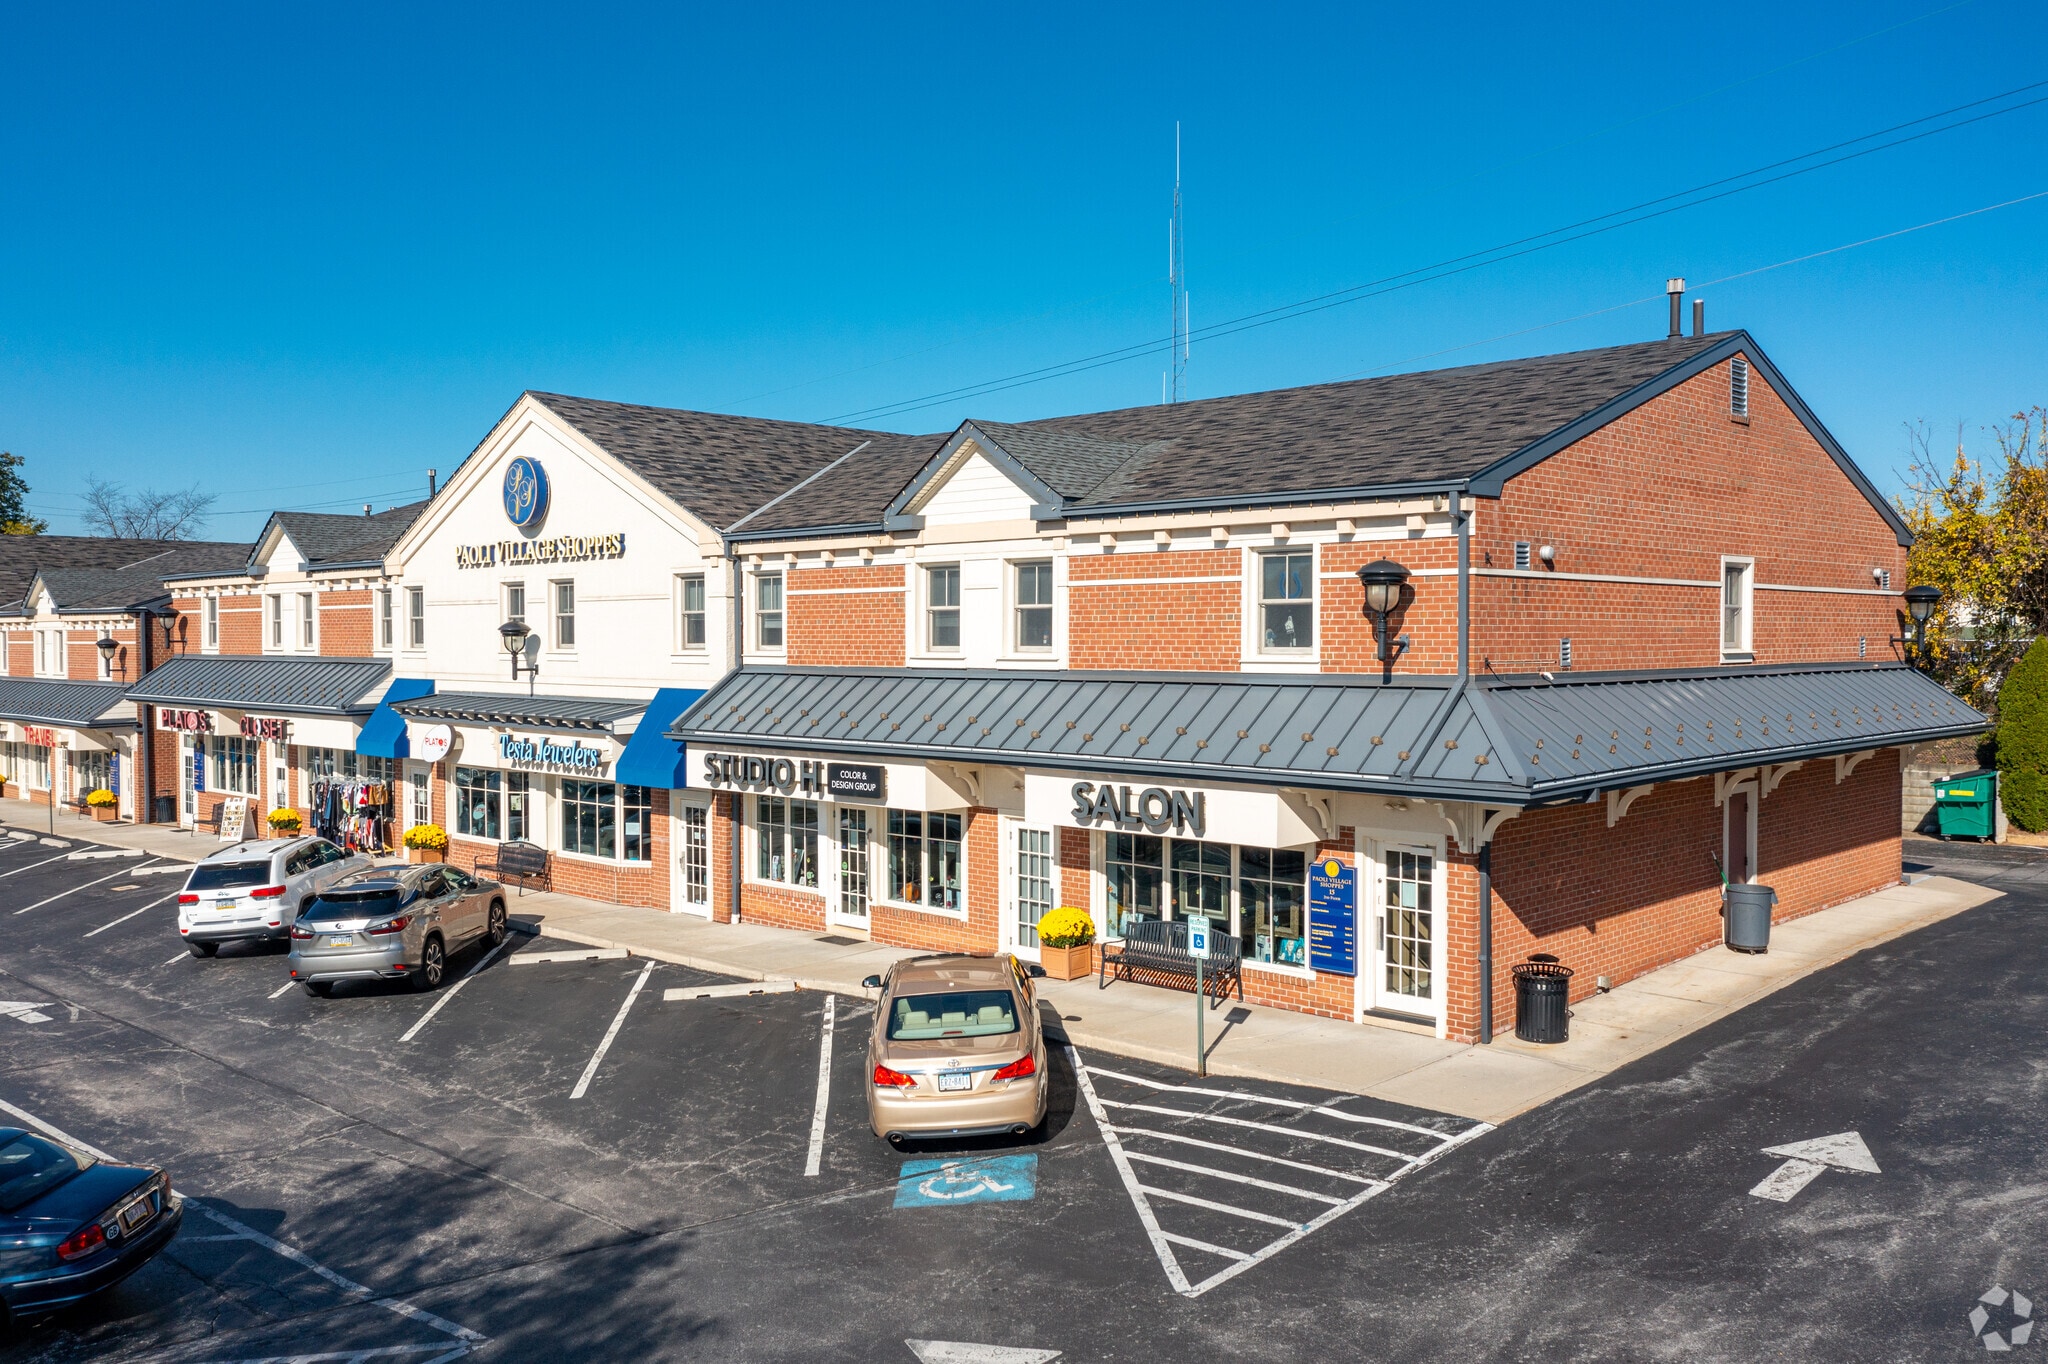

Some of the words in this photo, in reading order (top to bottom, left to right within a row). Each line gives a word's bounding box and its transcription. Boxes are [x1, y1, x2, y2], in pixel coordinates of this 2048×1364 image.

[456, 543, 495, 566] PAOLI
[497, 539, 556, 562] VILLAGE
[556, 533, 625, 558] SHOPPES
[23, 726, 57, 748] TRAVEL
[240, 716, 286, 740] CLOSET
[500, 734, 533, 762] Testa
[535, 737, 599, 769] Jewelers
[703, 753, 795, 789] STUDIO
[800, 760, 821, 792] H
[840, 770, 861, 780] COLOR
[861, 772, 868, 780] &
[831, 780, 854, 790] DESIGN
[854, 782, 876, 792] GROUP
[1070, 781, 1202, 830] SALON
[1312, 875, 1328, 883] PAOLI
[1329, 877, 1352, 885] VILLAGE
[108, 1226, 118, 1238] GB
